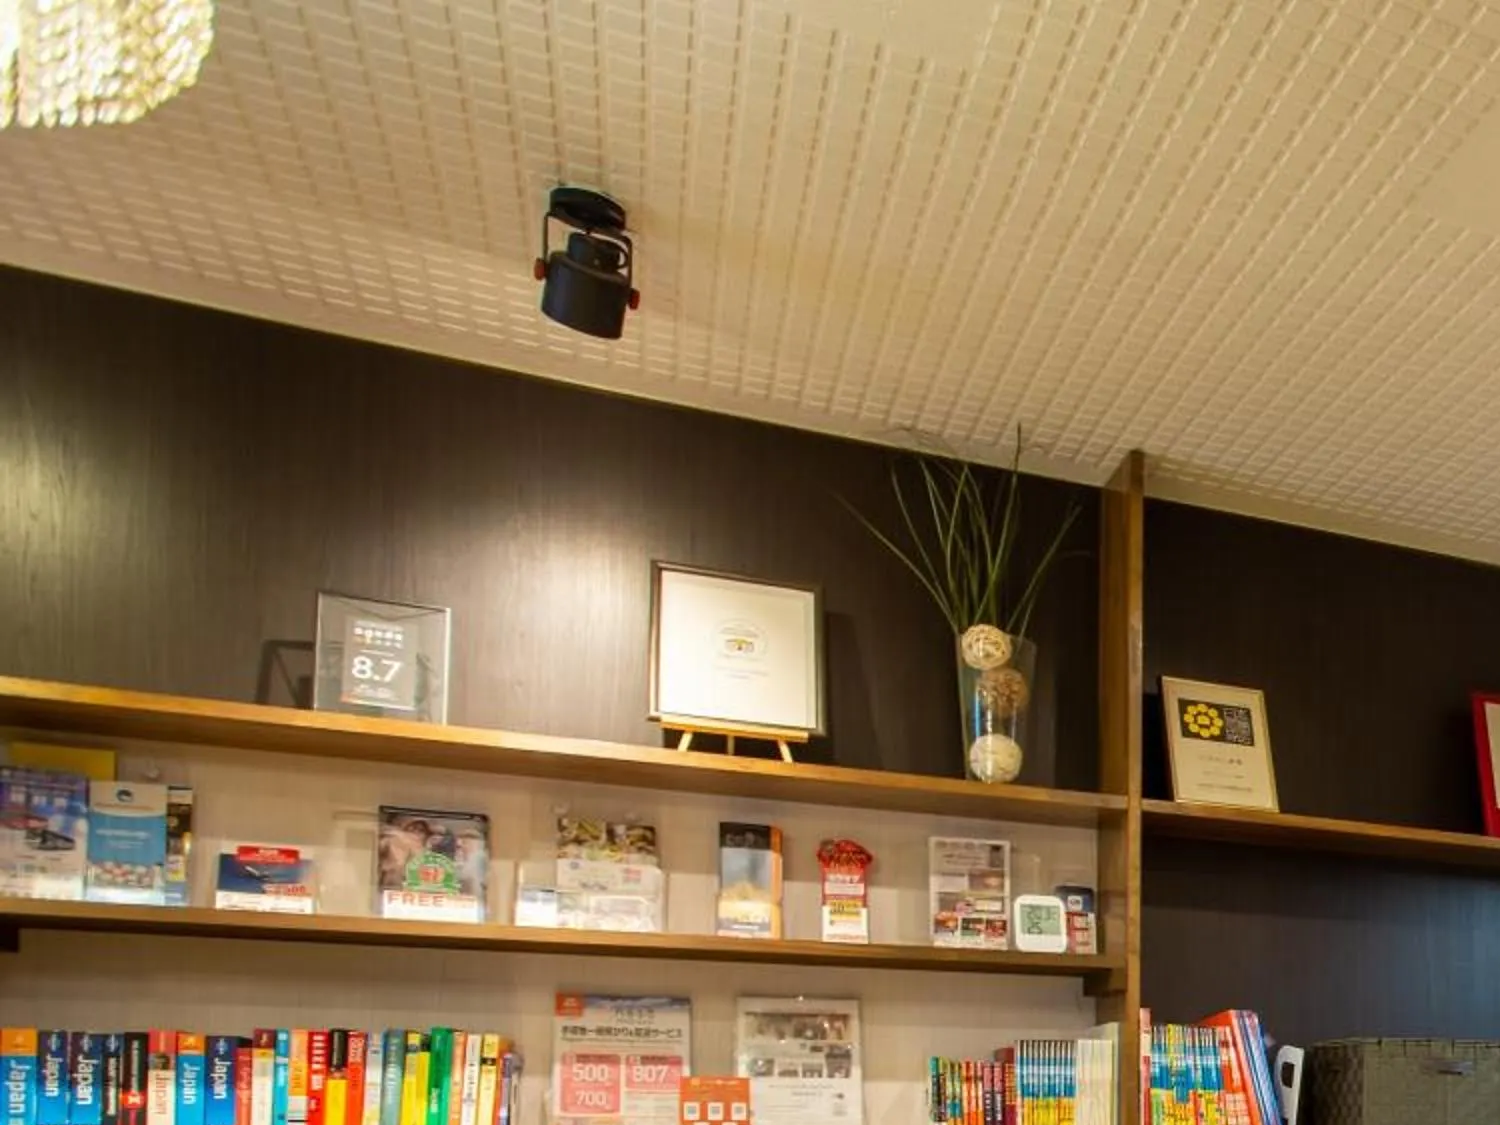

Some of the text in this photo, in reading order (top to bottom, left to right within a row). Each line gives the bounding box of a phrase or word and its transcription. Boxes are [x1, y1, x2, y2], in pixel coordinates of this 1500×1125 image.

[351, 655, 403, 682] 8.7
[387, 892, 445, 907] FREE
[4, 1060, 31, 1114] Japan
[44, 1055, 63, 1097] Japan
[72, 1055, 99, 1105] Japan
[153, 1069, 170, 1115] Japan
[181, 1063, 200, 1104] Japan
[210, 1058, 231, 1099] Japan
[573, 1064, 609, 1082] 500
